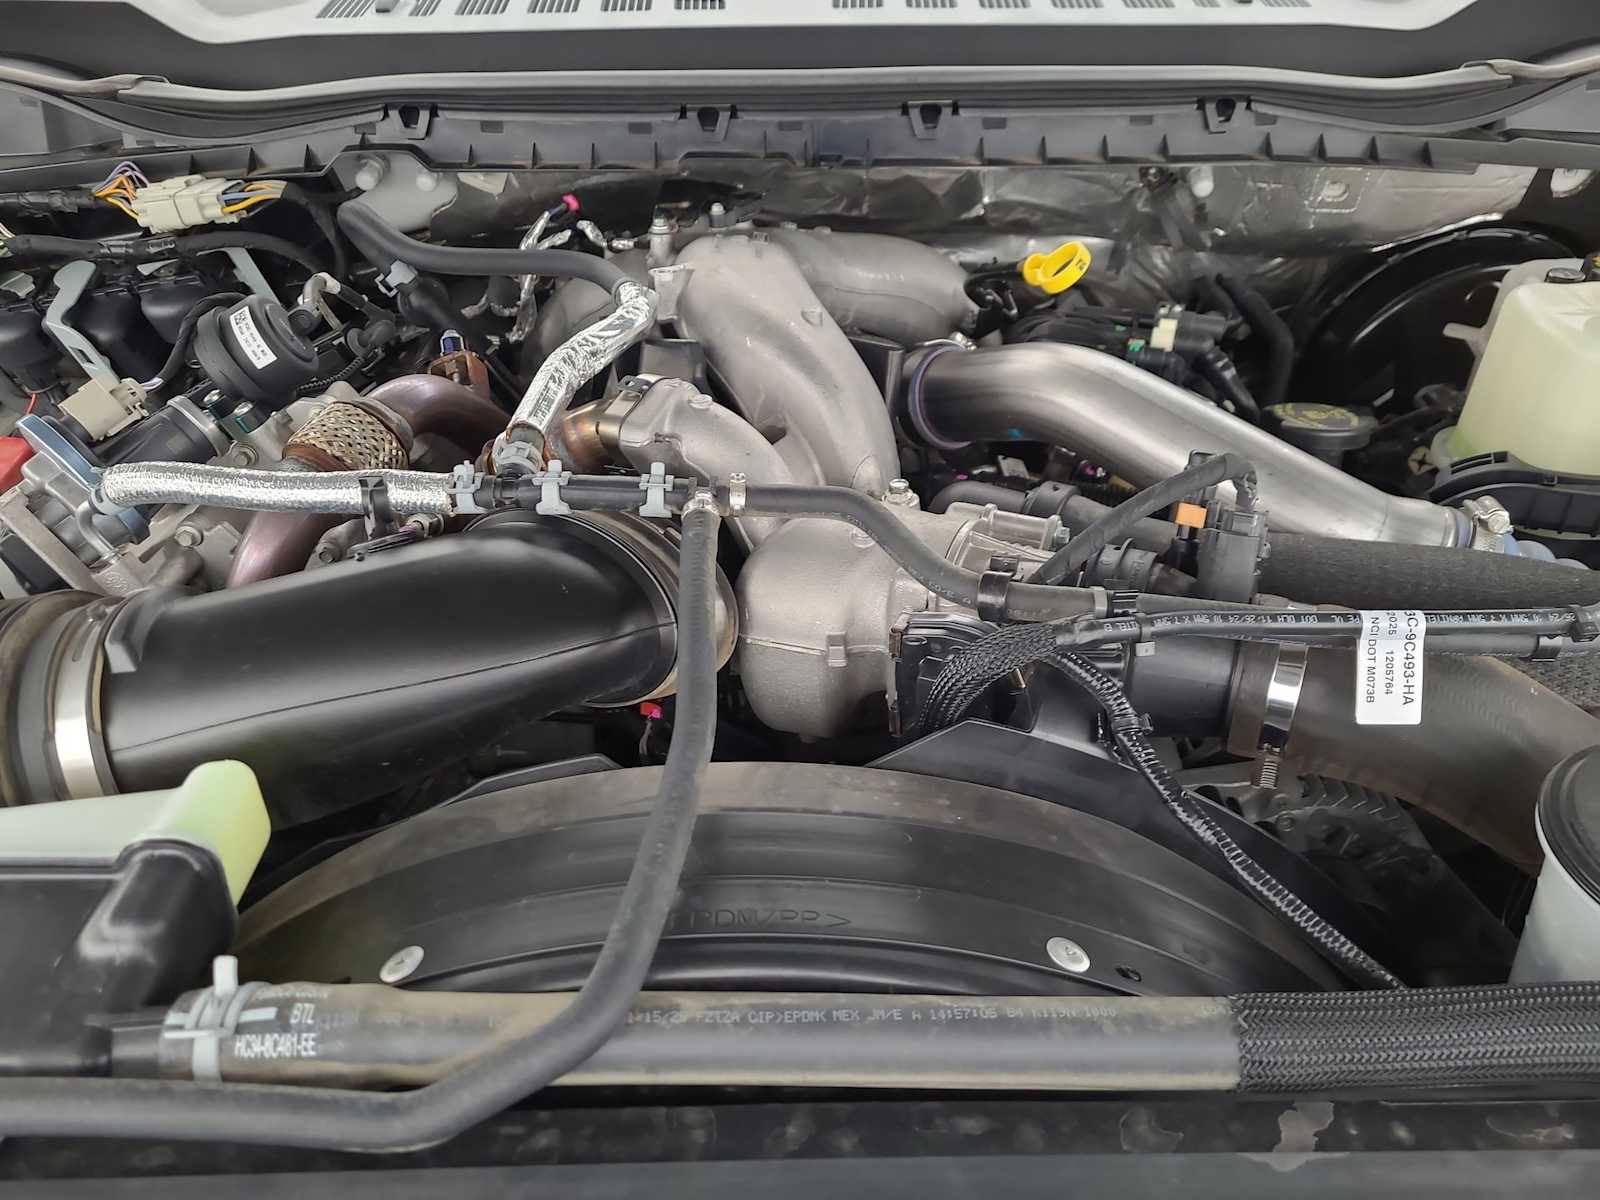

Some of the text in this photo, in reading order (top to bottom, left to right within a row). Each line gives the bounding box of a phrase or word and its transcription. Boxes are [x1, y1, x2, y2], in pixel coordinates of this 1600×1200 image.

[1365, 616, 1380, 703] NCI DOT M073B
[1384, 650, 1395, 695] 1205764
